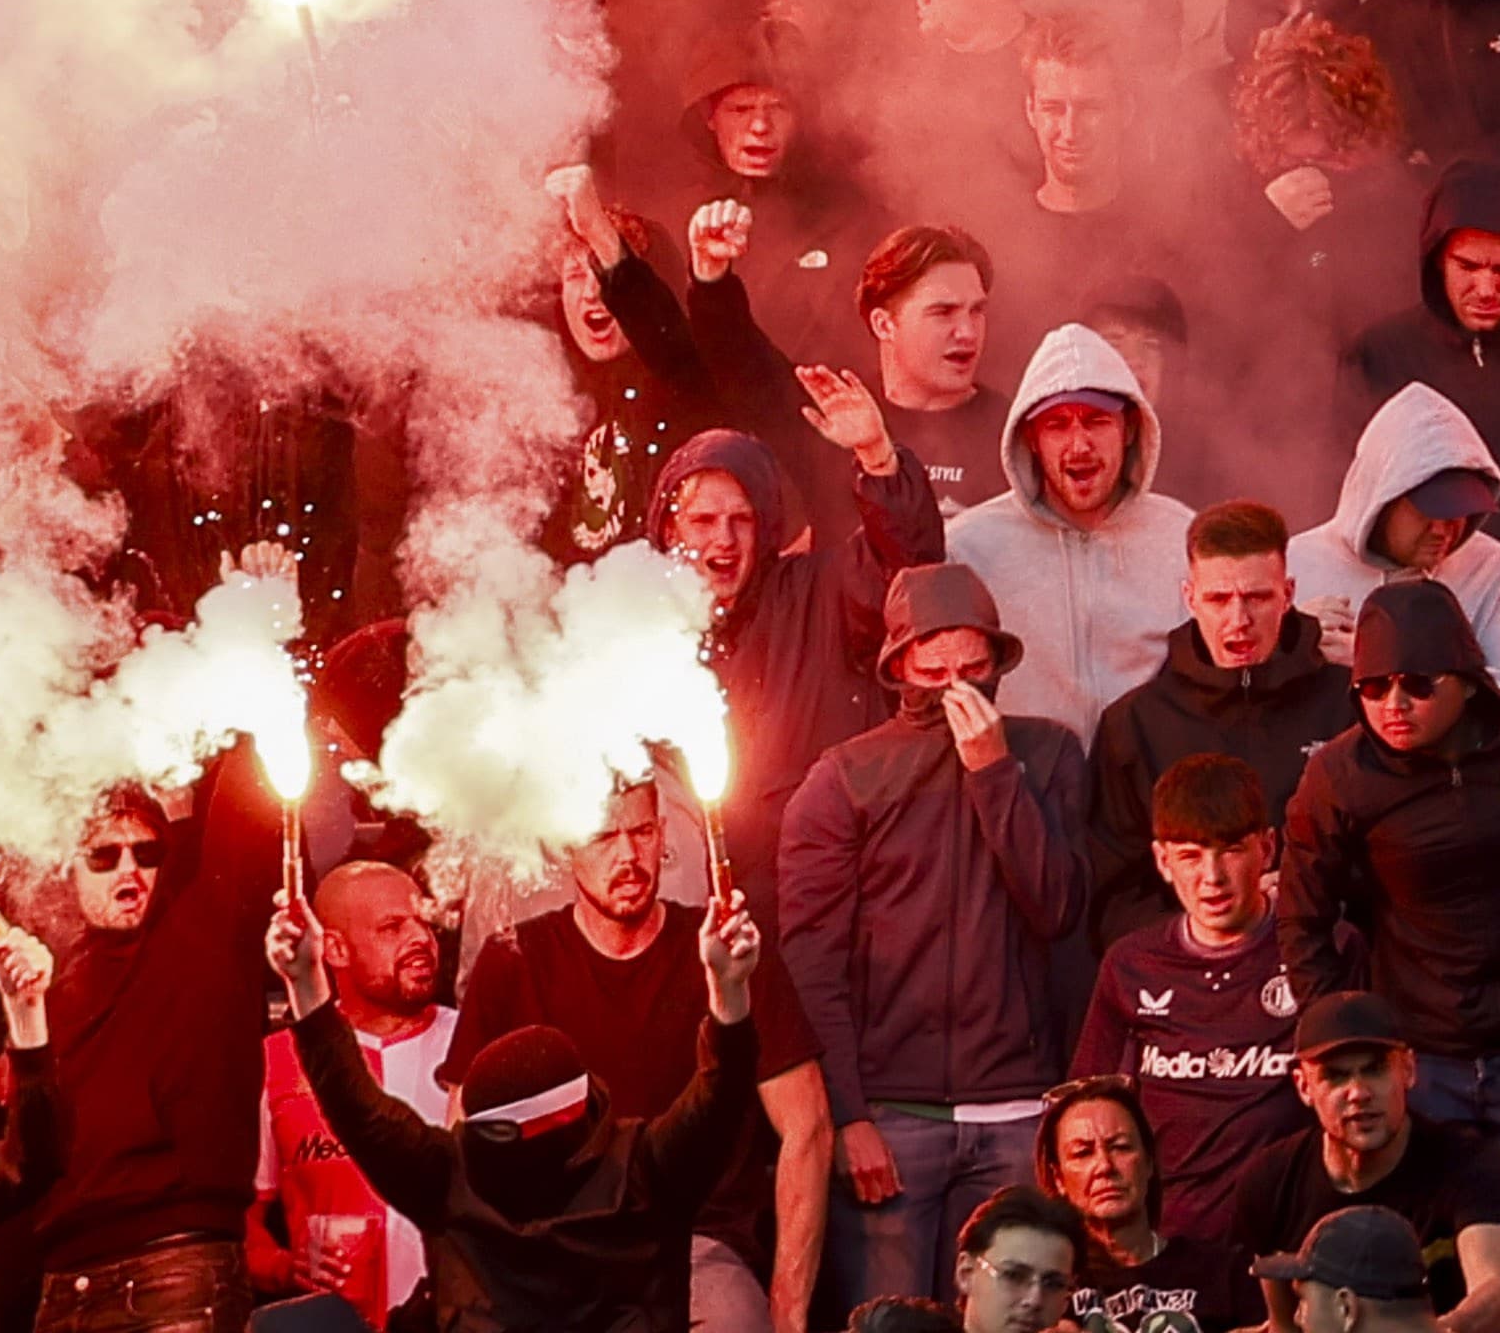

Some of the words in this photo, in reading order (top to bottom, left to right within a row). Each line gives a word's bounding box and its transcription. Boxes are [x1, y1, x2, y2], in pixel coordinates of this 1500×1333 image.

[925, 465, 964, 482] STYLE
[1140, 1045, 1206, 1079] Media
[1230, 1045, 1297, 1078] Mar
